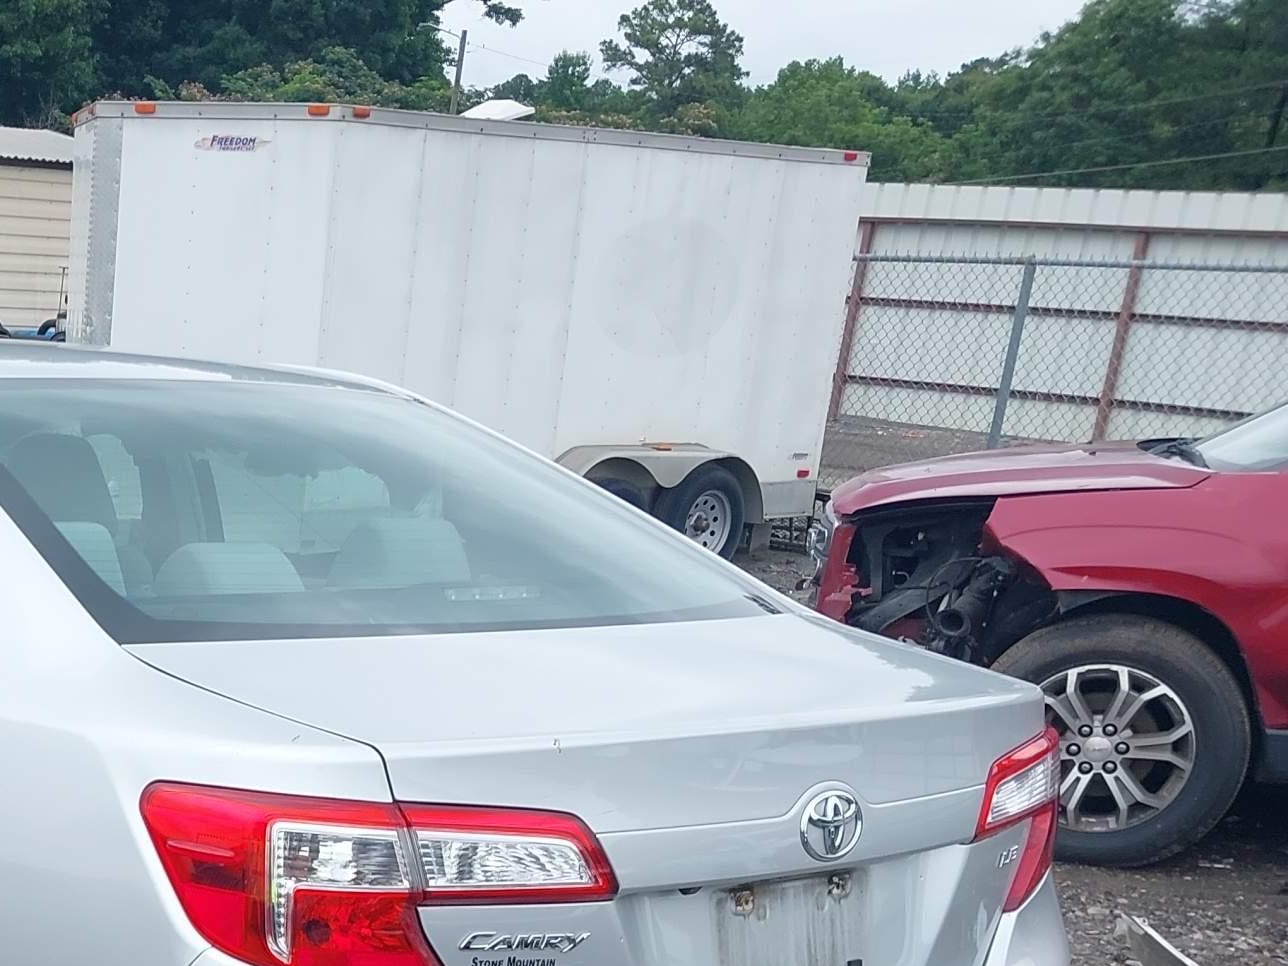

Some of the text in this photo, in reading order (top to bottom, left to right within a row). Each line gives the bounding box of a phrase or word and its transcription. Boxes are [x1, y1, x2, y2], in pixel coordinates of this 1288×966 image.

[210, 135, 257, 147] FREEDOM
[997, 845, 1019, 868] LE
[458, 931, 591, 953] CAMRY
